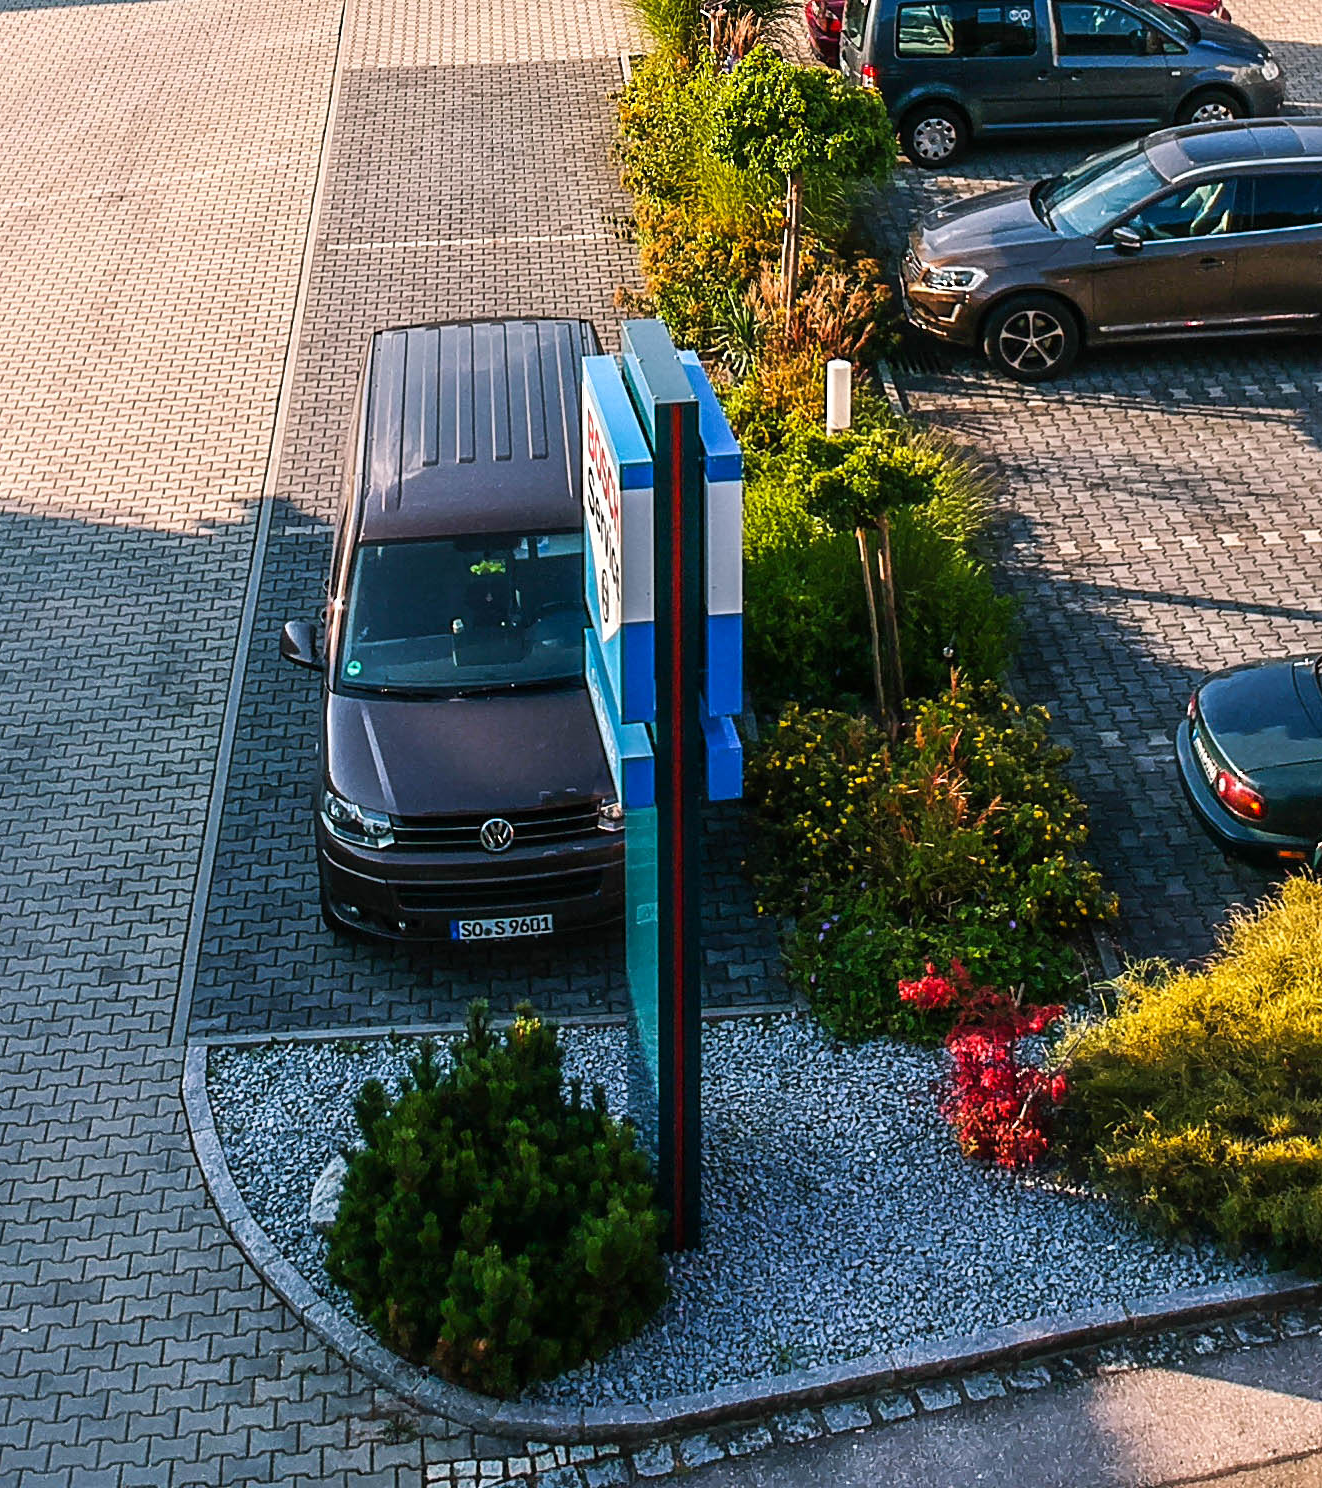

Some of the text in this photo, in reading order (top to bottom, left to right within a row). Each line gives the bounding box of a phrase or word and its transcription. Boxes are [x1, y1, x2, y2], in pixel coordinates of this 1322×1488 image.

[461, 916, 551, 937] SO S 9601
